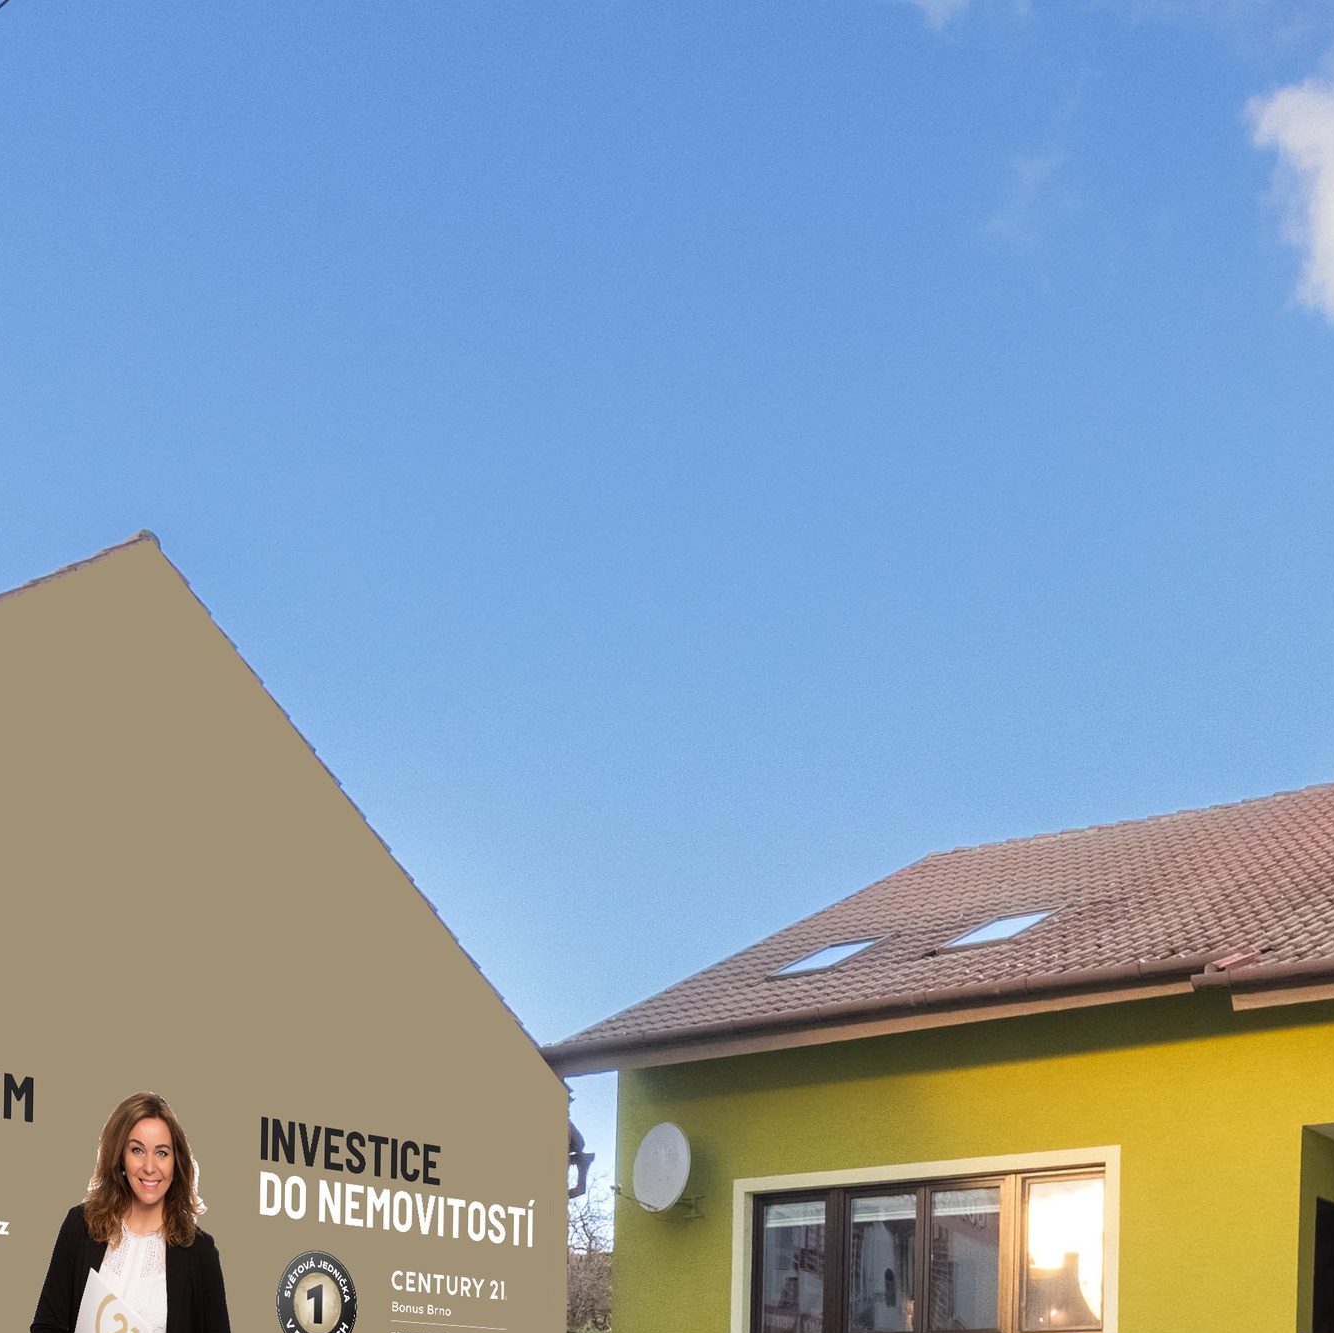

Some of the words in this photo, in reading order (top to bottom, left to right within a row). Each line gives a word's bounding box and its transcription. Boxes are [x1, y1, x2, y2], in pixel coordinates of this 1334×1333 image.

[260, 1116, 441, 1186] INVESTICE
[259, 1171, 307, 1220] DO
[318, 1179, 535, 1248] NEMOVITOSTÍ
[284, 1257, 316, 1299] SVĚTOVÁ
[317, 1260, 351, 1303] JEDNIČKA
[390, 1269, 485, 1298] CENTURY
[489, 1279, 505, 1301] 21
[285, 1317, 296, 1330] V
[306, 1283, 323, 1325] 1
[391, 1301, 424, 1315] Bonus
[427, 1304, 452, 1317] Brno
